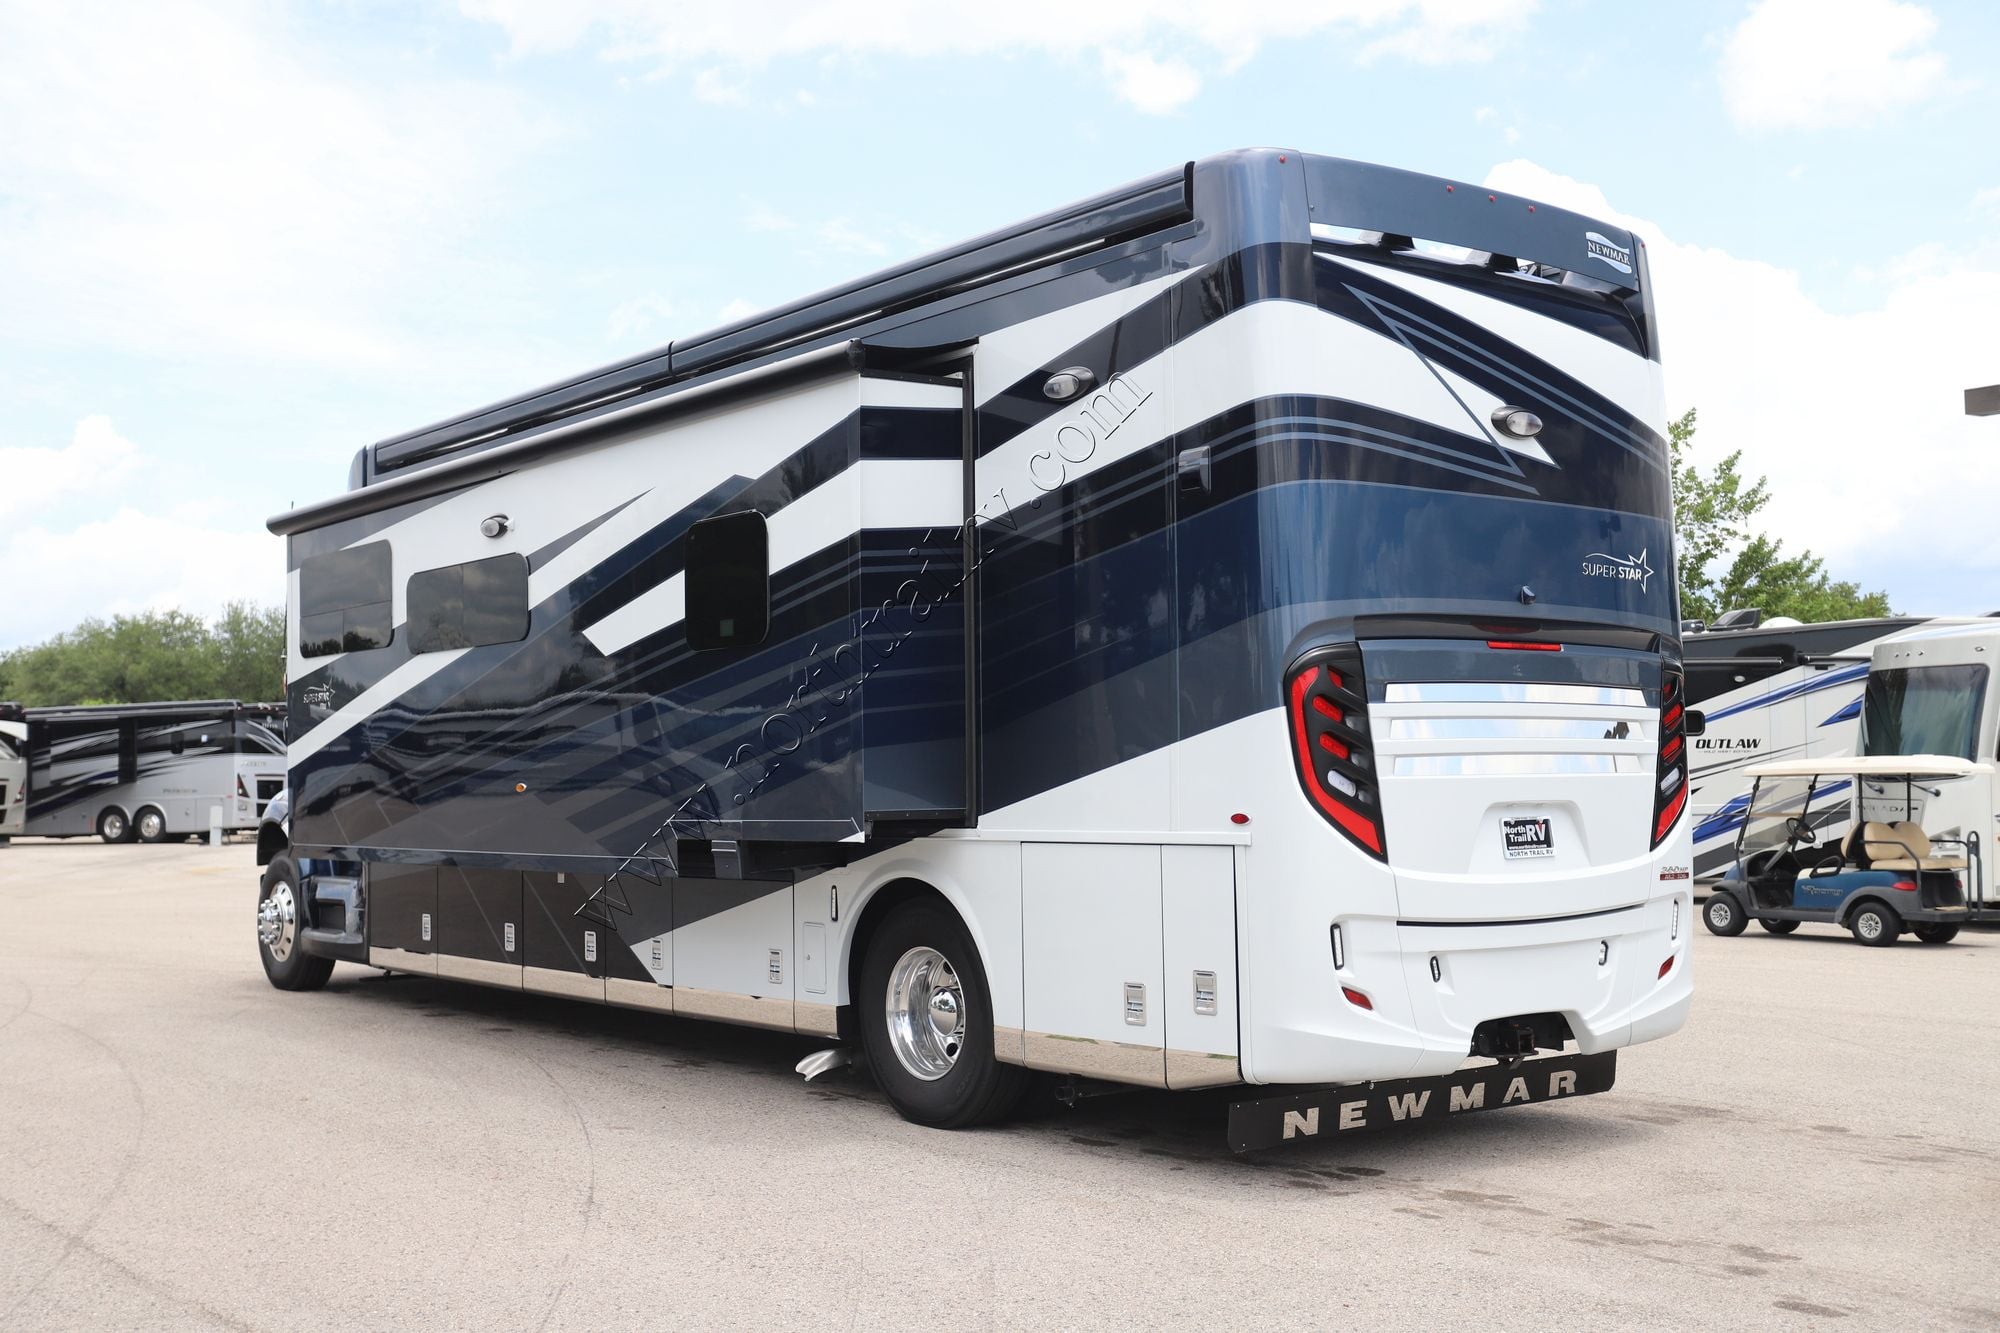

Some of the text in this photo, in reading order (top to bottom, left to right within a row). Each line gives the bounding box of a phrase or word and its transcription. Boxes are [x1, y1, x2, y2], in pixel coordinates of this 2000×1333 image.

[1587, 240, 1631, 266] NEWMAR
[1582, 562, 1642, 581] SUPER STAR
[1695, 738, 1761, 749] OUTLAW
[1503, 824, 1526, 834] North
[1509, 833, 1527, 843] Trail
[1525, 823, 1546, 842] RV
[1282, 1070, 1578, 1140] NEWMAR
